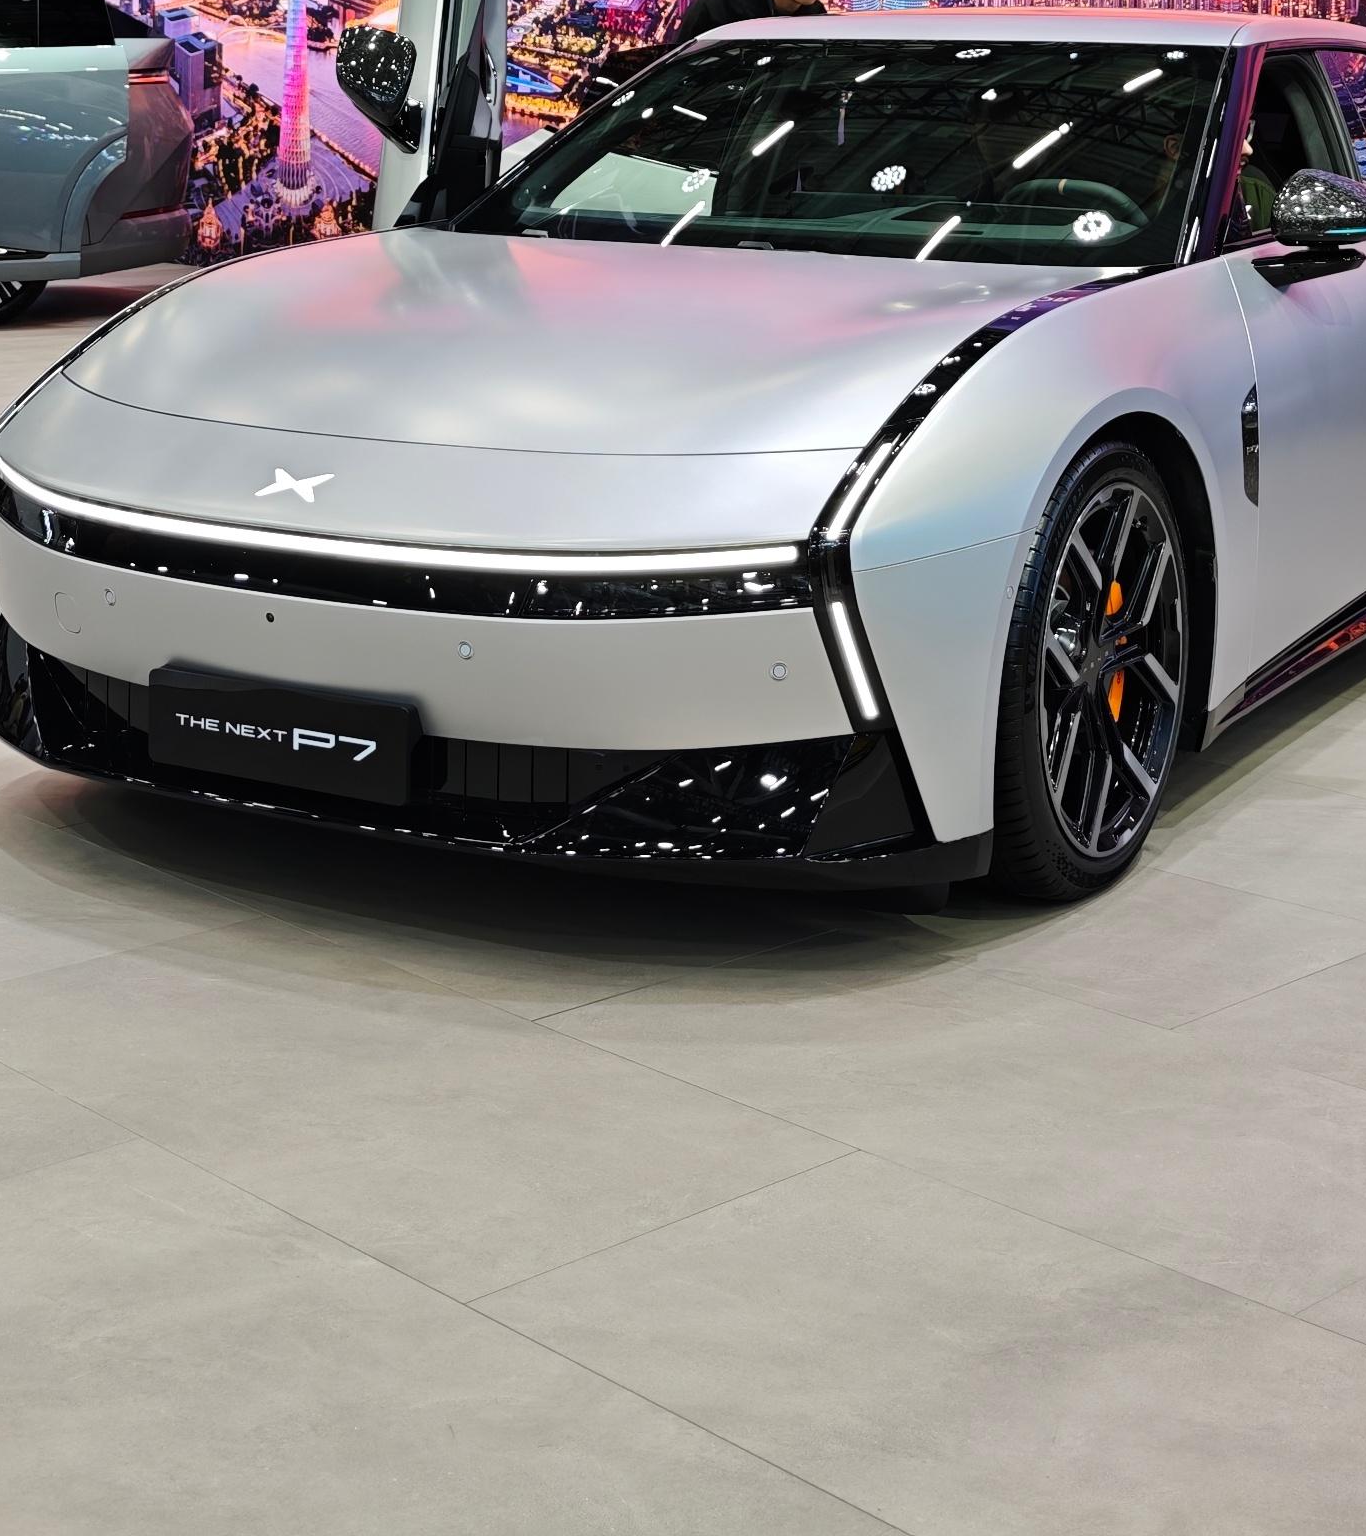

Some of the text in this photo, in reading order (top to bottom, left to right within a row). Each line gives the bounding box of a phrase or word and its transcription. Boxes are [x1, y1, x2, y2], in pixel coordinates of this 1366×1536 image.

[175, 712, 377, 762] THE NEXT P7
